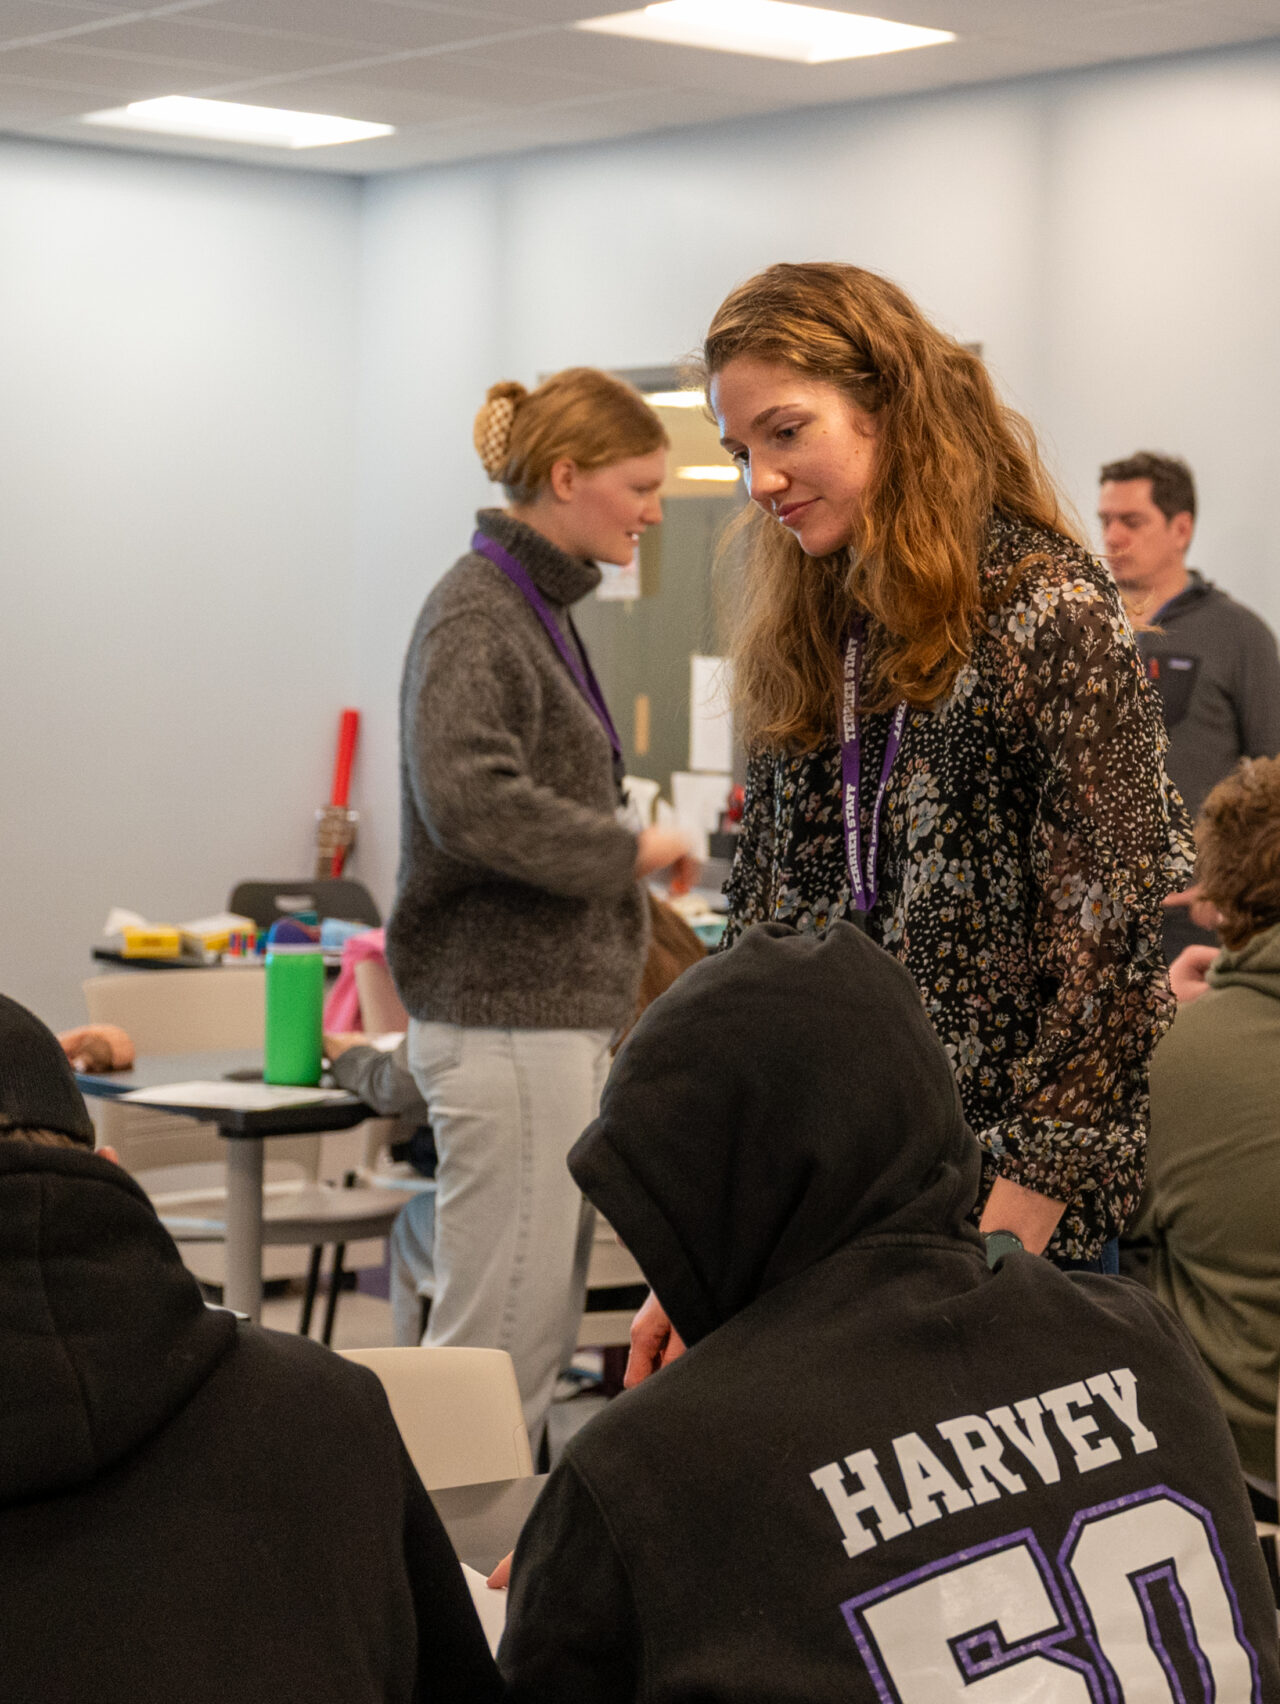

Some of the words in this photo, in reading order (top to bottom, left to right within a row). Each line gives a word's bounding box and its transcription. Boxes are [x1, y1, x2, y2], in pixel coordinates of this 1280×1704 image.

[844, 637, 858, 679] STAFF
[843, 680, 856, 743] TERRIER
[845, 783, 856, 829] STAFF
[848, 830, 862, 894] TERRIER
[866, 846, 876, 893] STAFF
[810, 1368, 1158, 1559] HARVEY
